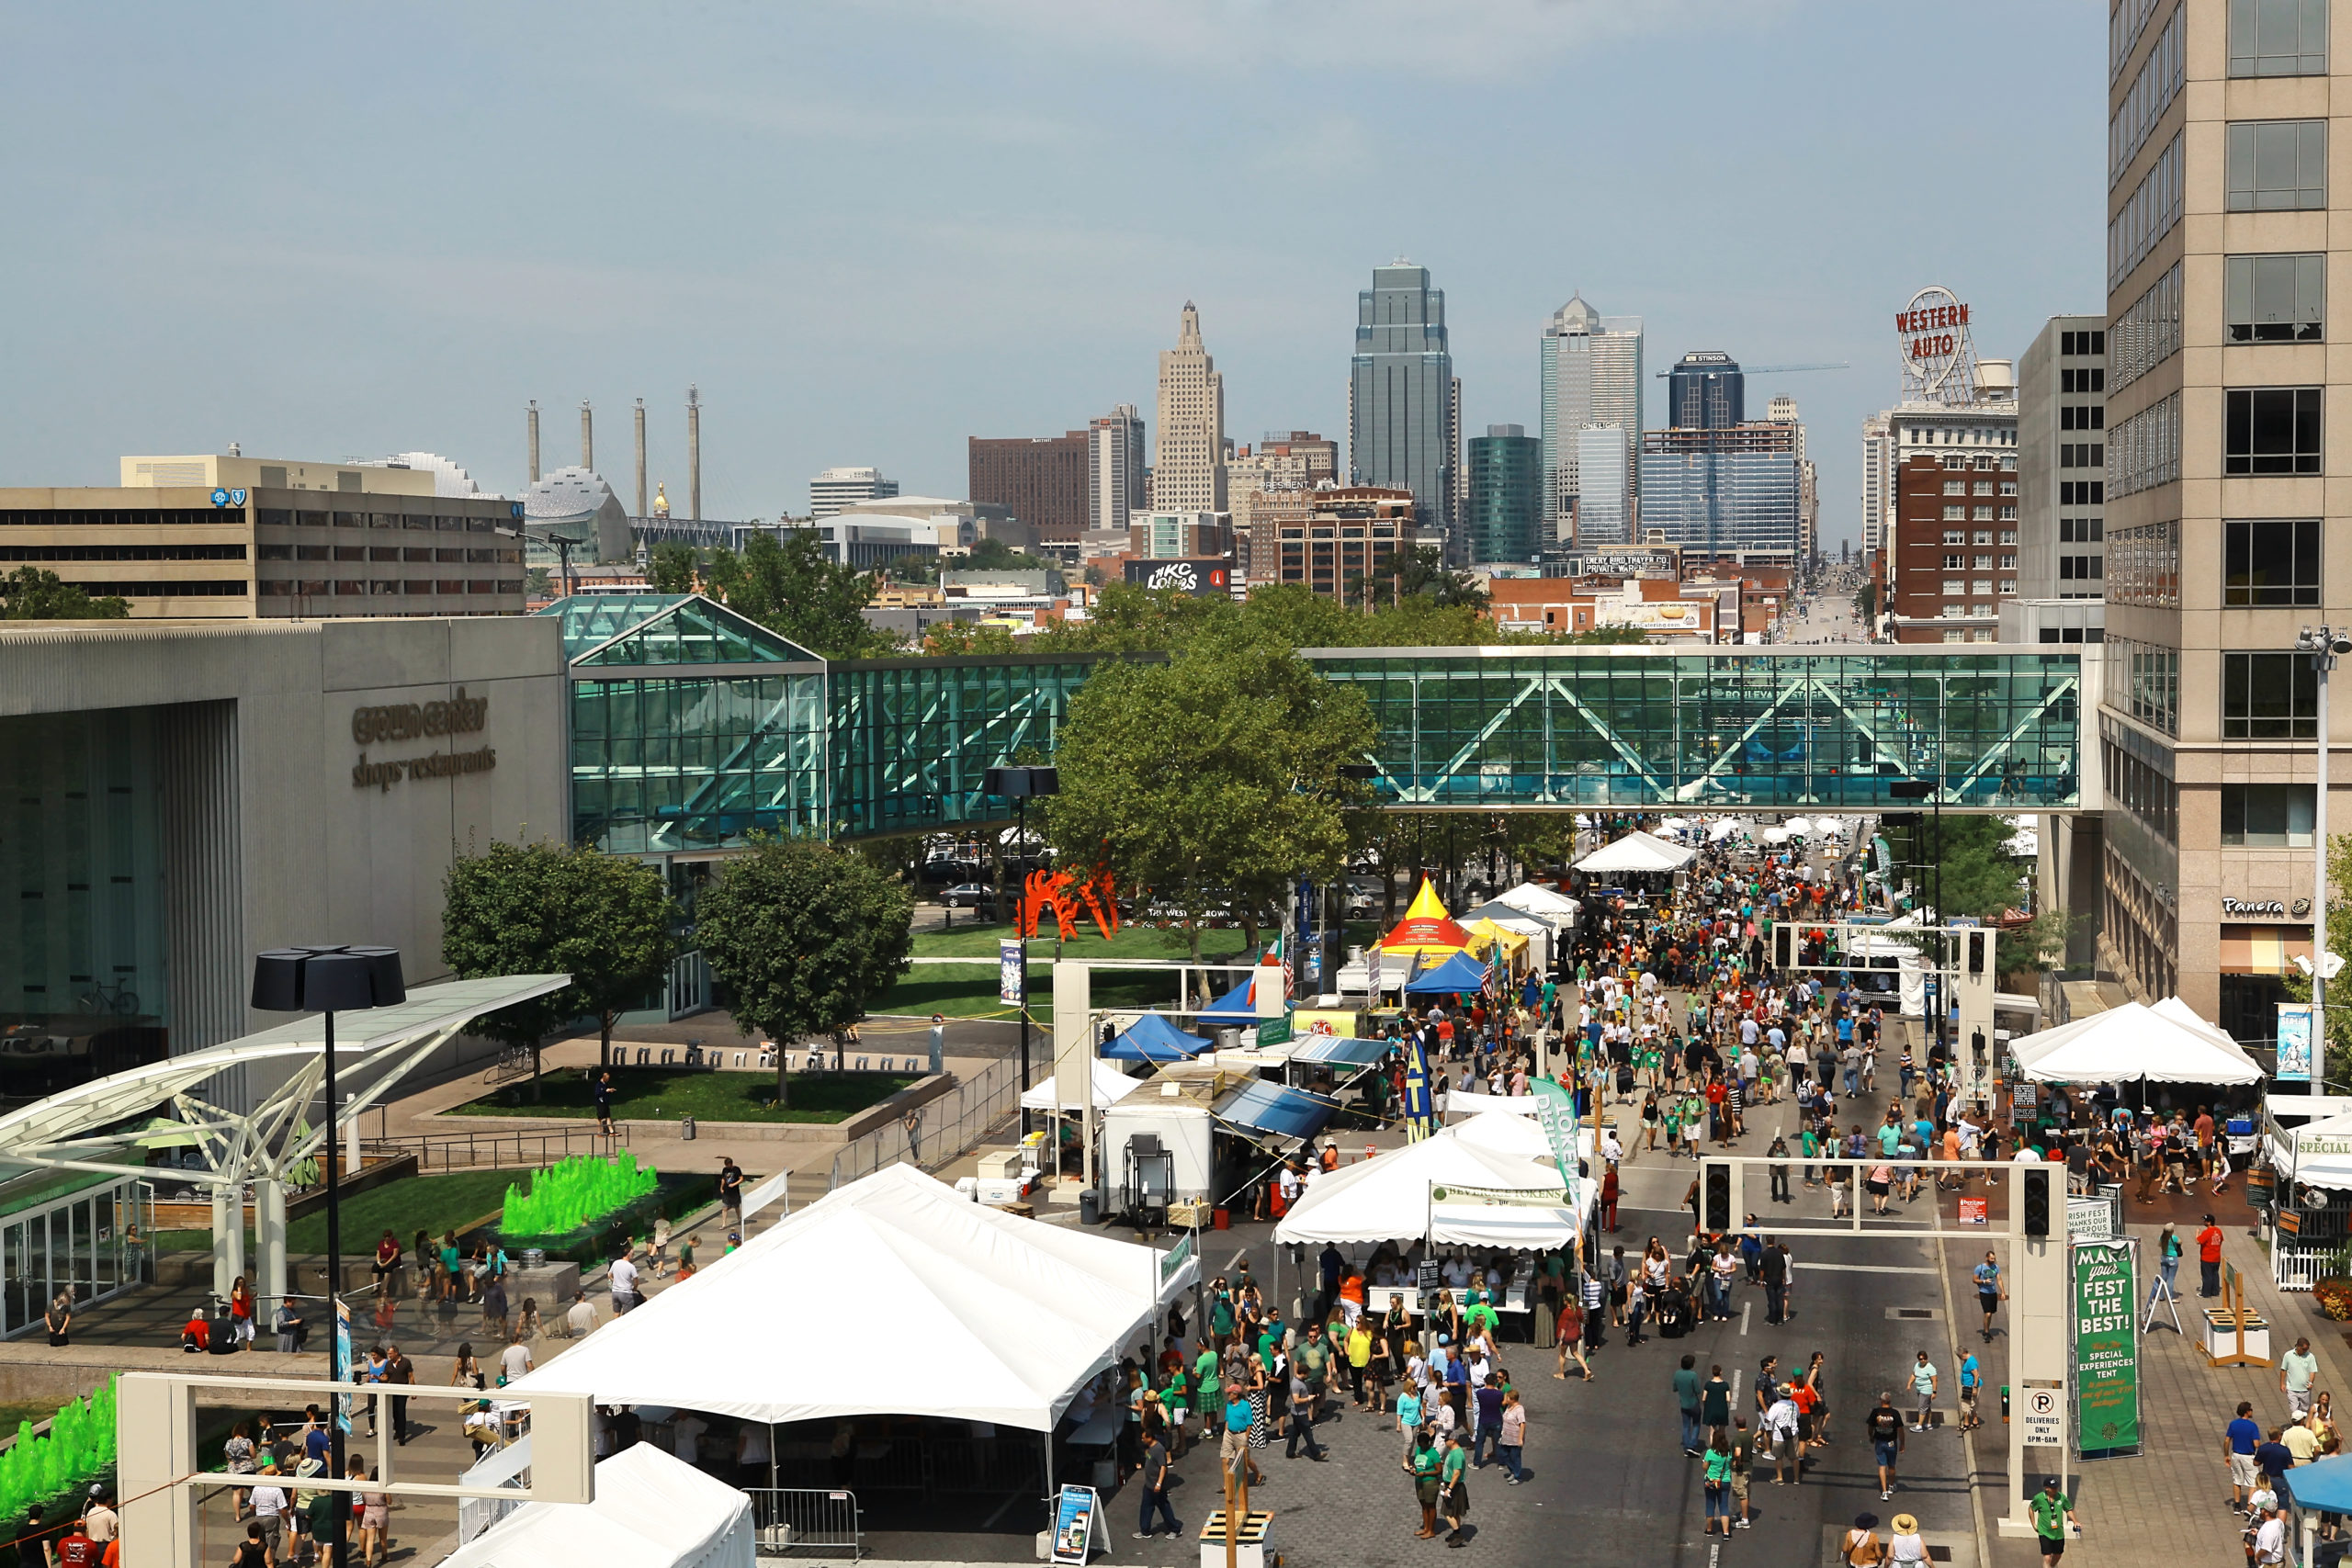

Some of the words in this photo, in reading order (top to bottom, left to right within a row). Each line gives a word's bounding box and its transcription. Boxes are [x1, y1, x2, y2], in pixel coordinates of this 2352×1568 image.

[1896, 304, 1968, 333] WESTERN
[1912, 334, 1953, 359] AUTO
[1155, 563, 1193, 579] #KC
[1586, 564, 1614, 573] PRIVATE
[352, 704, 423, 745] crown
[423, 686, 488, 737] center
[352, 752, 402, 794] shops
[408, 744, 496, 781] restaurants
[2222, 897, 2284, 912] Panera
[1406, 1041, 1430, 1145] ATM
[2299, 1142, 2351, 1154] SPECIAL
[1449, 1188, 1512, 1198] BEVERAGE
[1514, 1190, 1561, 1199] TOKENS
[2068, 1212, 2086, 1220] RISH
[2088, 1209, 2107, 1217] FEST
[2067, 1224, 2108, 1233] ENEROUS
[2077, 1249, 2128, 1266] MAKE
[2088, 1263, 2119, 1281] your
[2084, 1280, 2126, 1298] FEST
[2087, 1298, 2122, 1314] THE
[2081, 1314, 2130, 1334] BEST!
[2089, 1350, 2123, 1360] SPECIAL
[2079, 1359, 2133, 1371] EXPERIENCES
[2097, 1370, 2117, 1379] TENT
[2026, 1416, 2060, 1425] DELIVERIES
